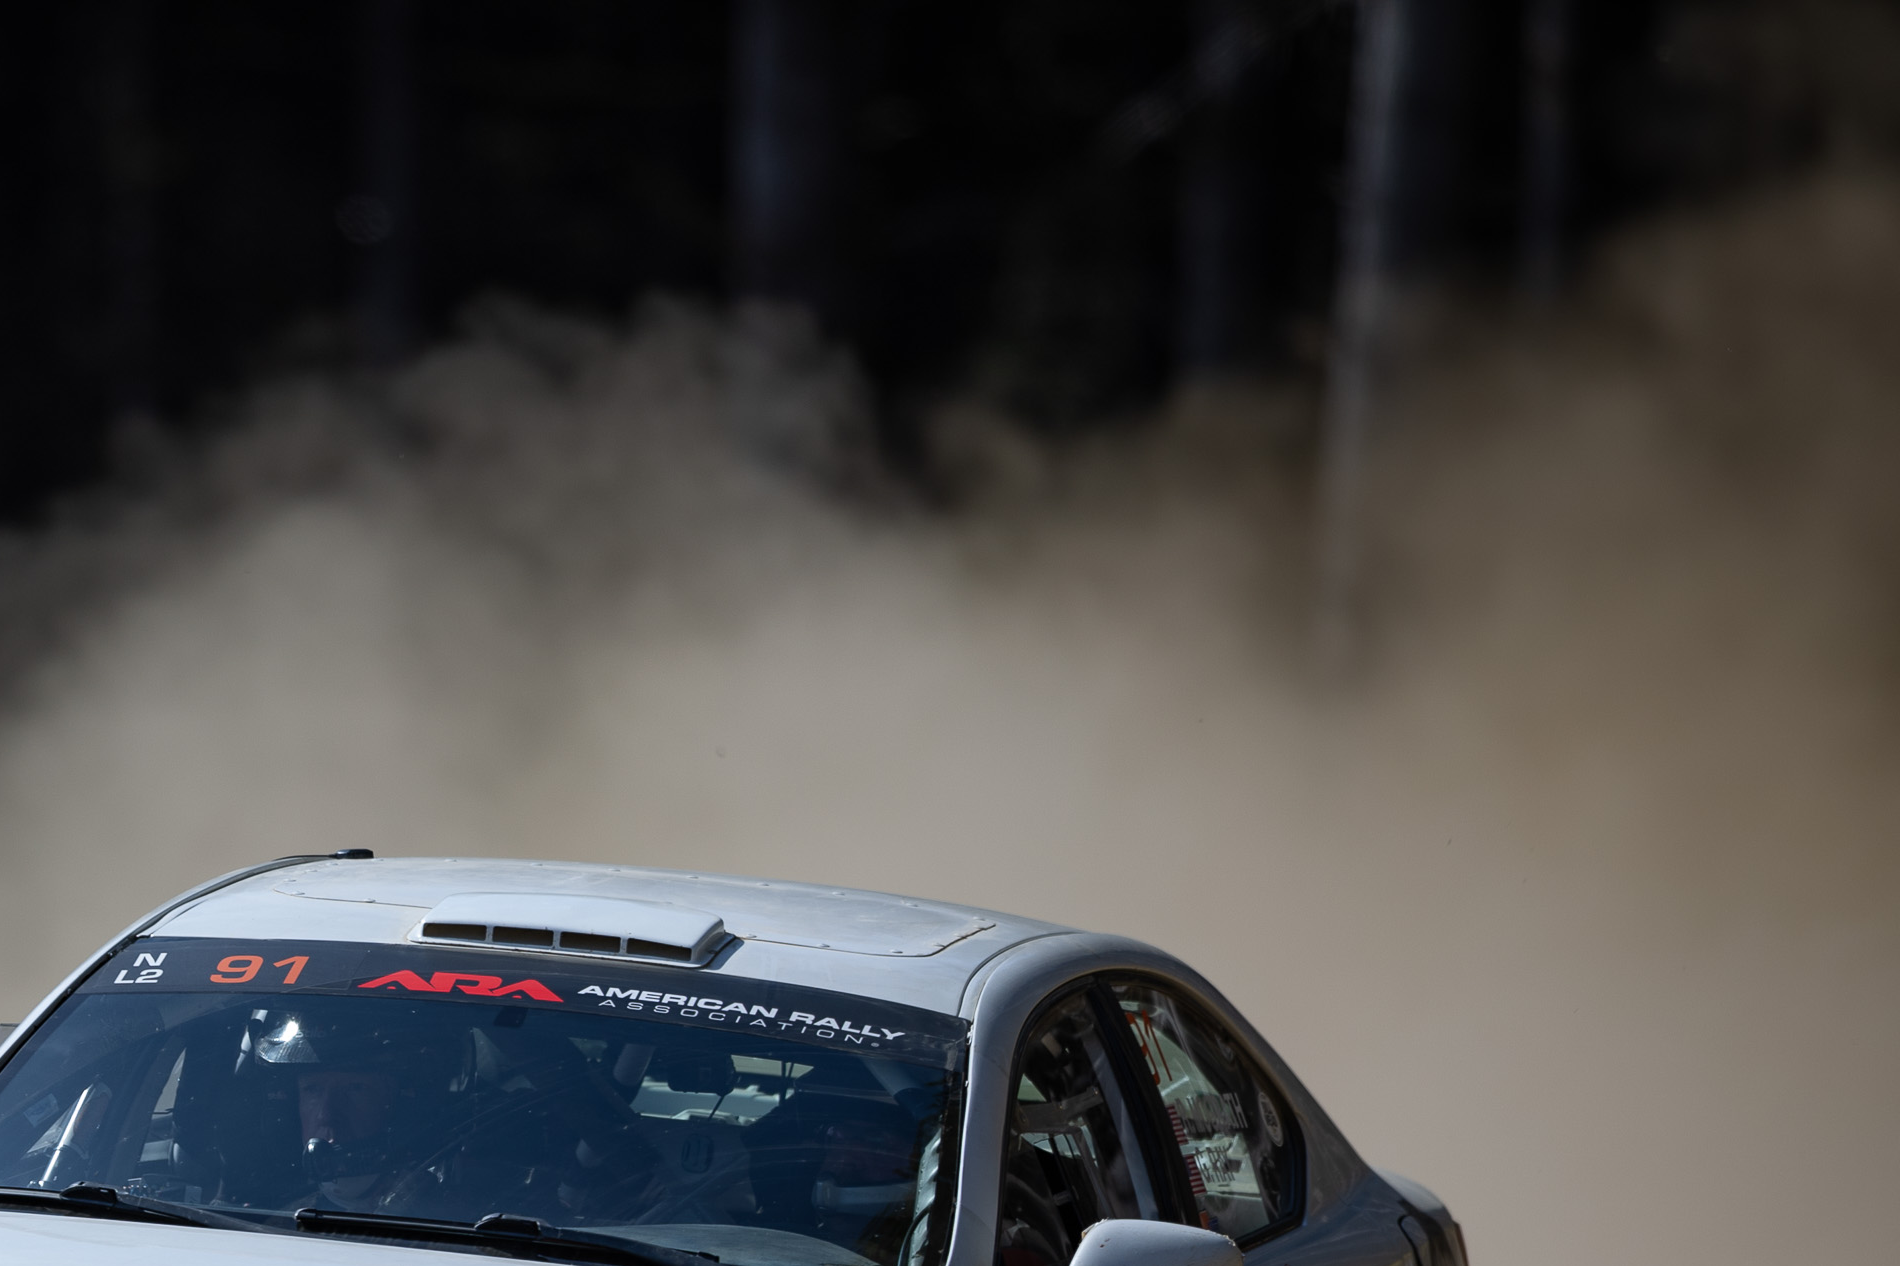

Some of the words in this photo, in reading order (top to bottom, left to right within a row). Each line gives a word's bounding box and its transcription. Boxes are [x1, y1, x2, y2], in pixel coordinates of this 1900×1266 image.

[133, 952, 168, 967] N
[209, 955, 310, 985] 91
[114, 968, 164, 985] L2
[357, 969, 565, 1003] ARA
[577, 984, 778, 1019] AMERICAN
[788, 1010, 906, 1041] RALLY
[597, 999, 872, 1045] ASSOCIATION
